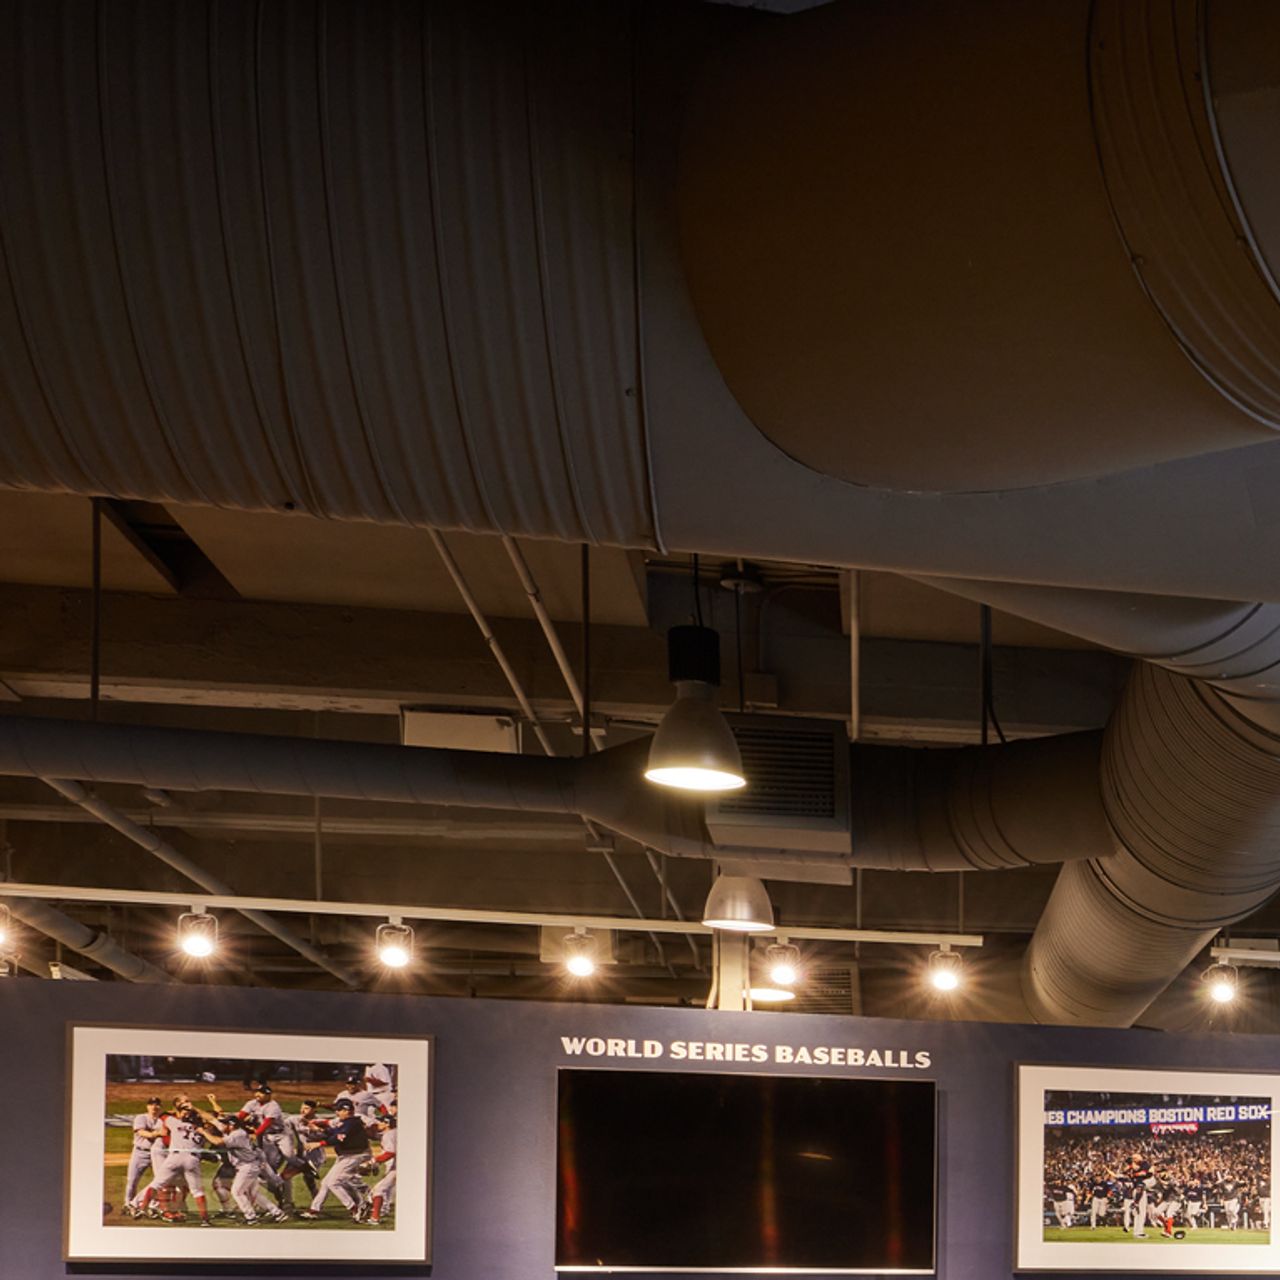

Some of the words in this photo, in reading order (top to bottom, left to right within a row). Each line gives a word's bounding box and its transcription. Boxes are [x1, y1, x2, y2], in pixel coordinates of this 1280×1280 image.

[560, 1036, 664, 1059] WORLD
[669, 1041, 769, 1063] SERIES
[774, 1045, 932, 1069] BASEBALLS
[1067, 1108, 1148, 1124] CHAMPIONS
[1149, 1107, 1204, 1123] BOSTON
[1207, 1106, 1235, 1121] RED
[1238, 1104, 1269, 1120] SOX
